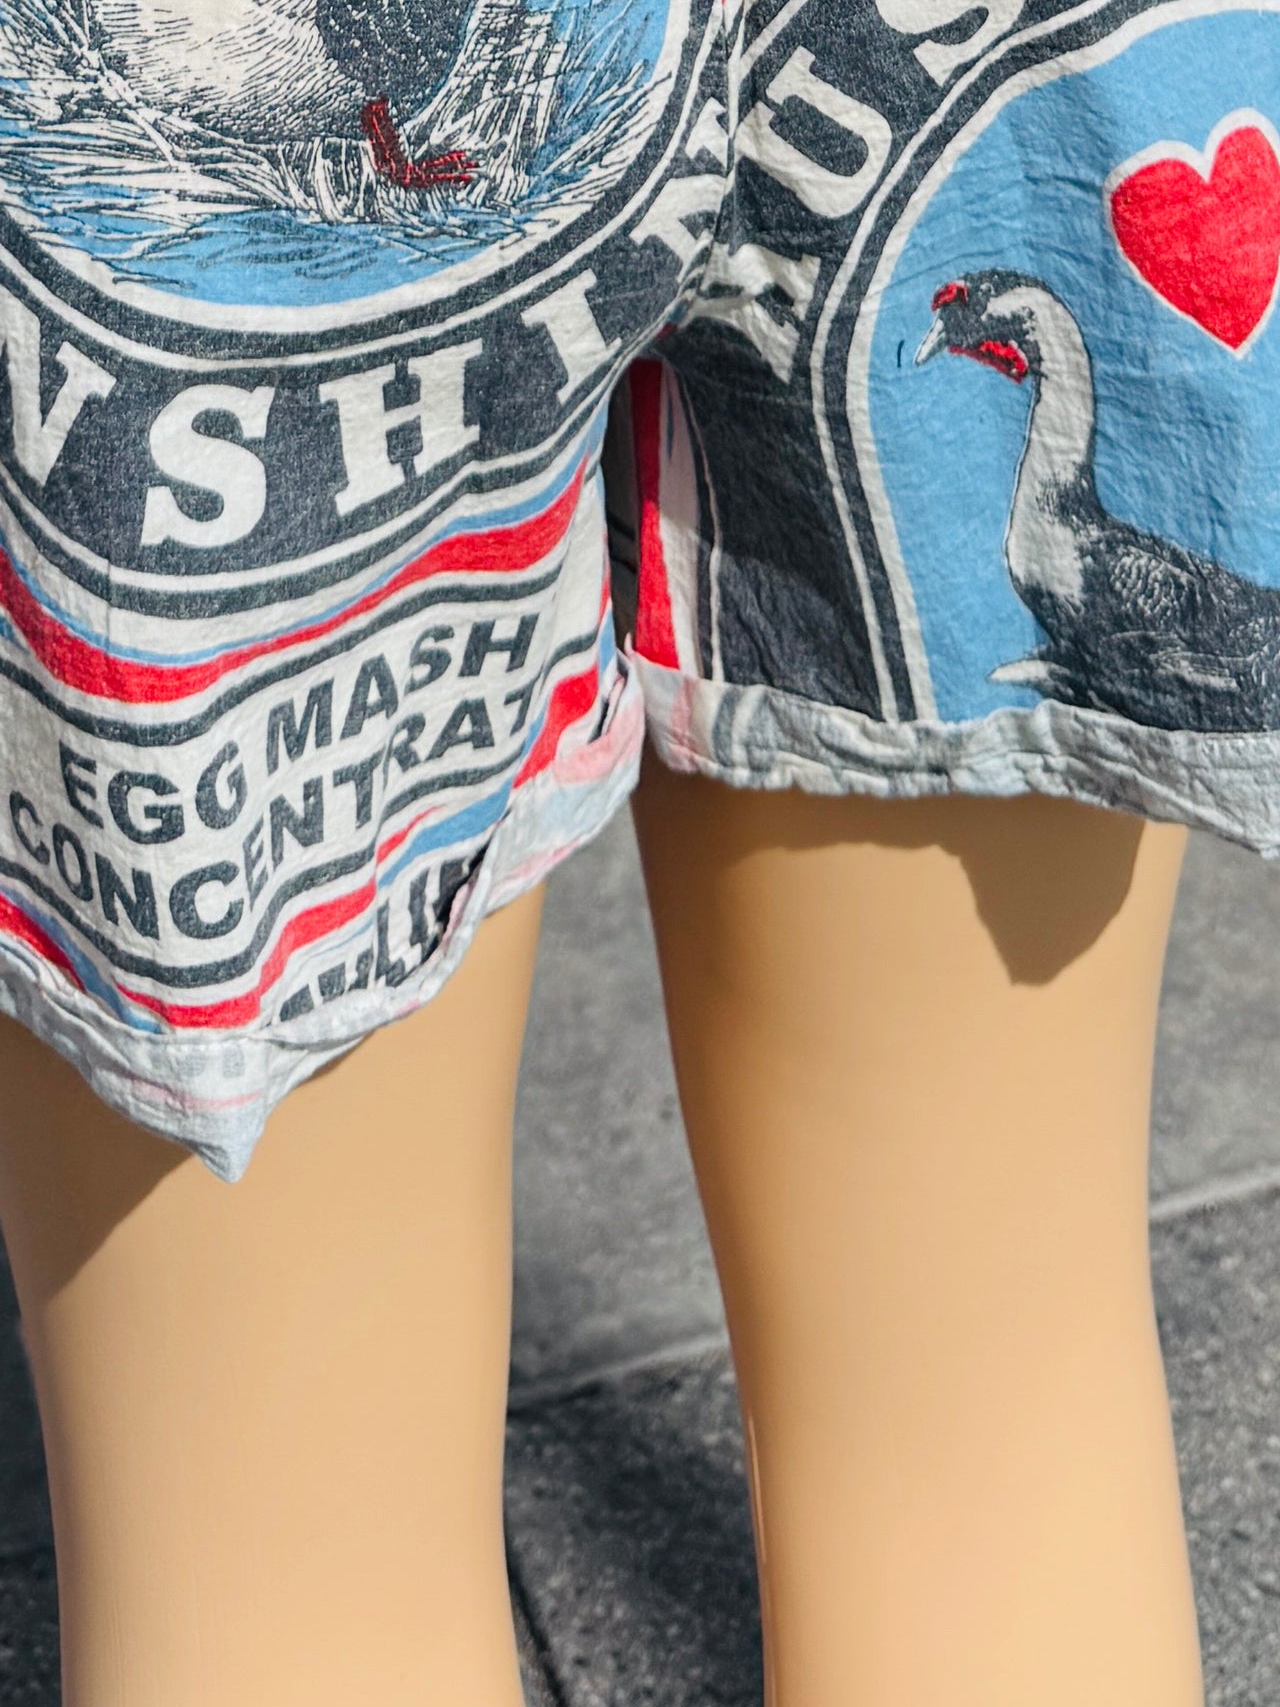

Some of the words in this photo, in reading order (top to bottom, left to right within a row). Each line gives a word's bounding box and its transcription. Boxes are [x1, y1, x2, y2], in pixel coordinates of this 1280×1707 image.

[8, 683, 538, 943] CONCENTRAT
[58, 738, 250, 846] EGG
[265, 610, 541, 777] MASH
